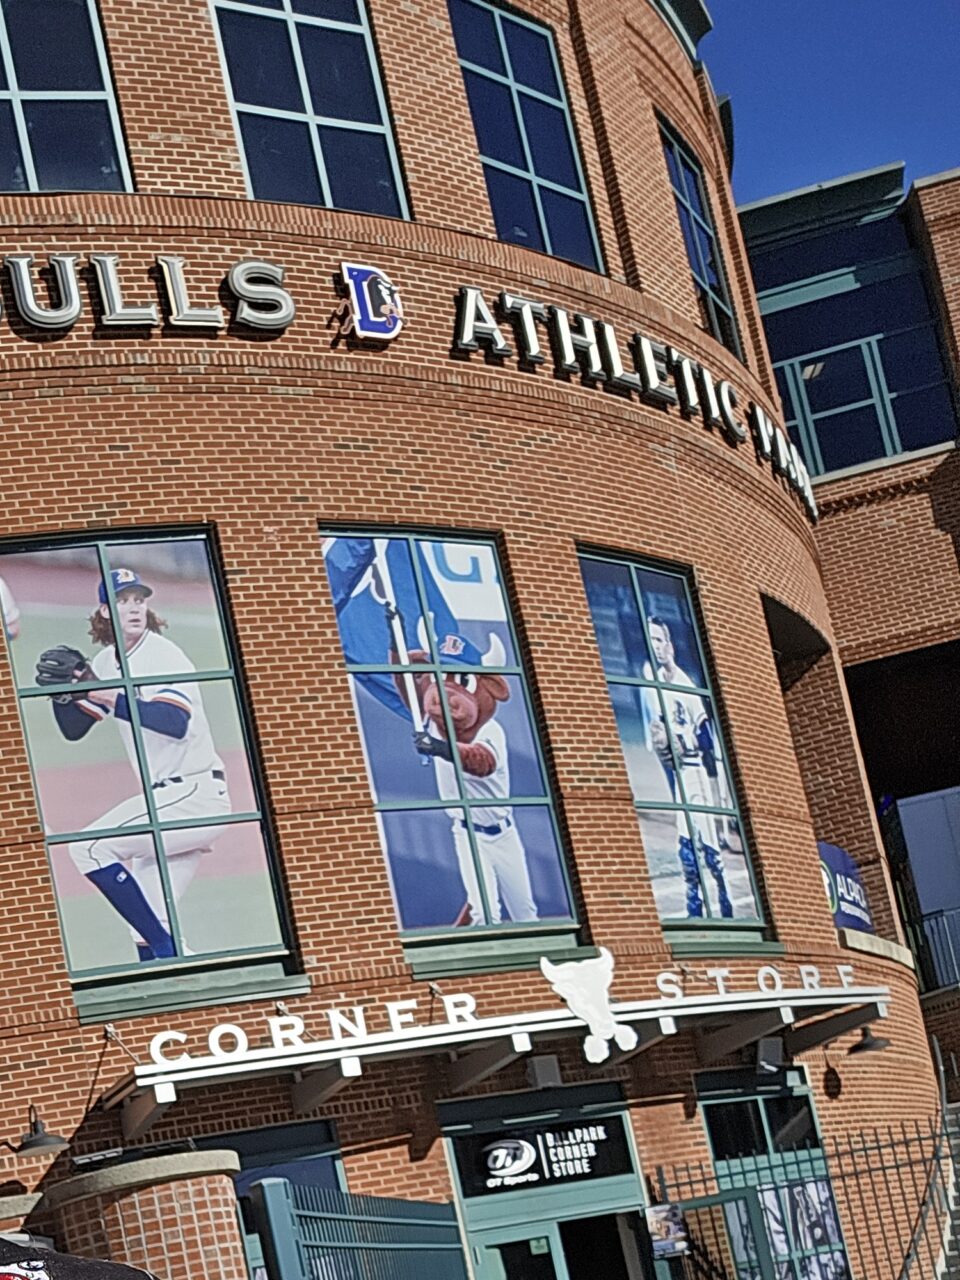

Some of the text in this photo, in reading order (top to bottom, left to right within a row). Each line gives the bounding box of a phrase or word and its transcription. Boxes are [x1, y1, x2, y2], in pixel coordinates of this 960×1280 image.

[457, 285, 747, 444] ATHLETIC
[149, 992, 480, 1065] CORNER
[549, 1142, 598, 1163] CORNER
[552, 1158, 593, 1178] STORE
[486, 1172, 540, 1188] OT Sports
